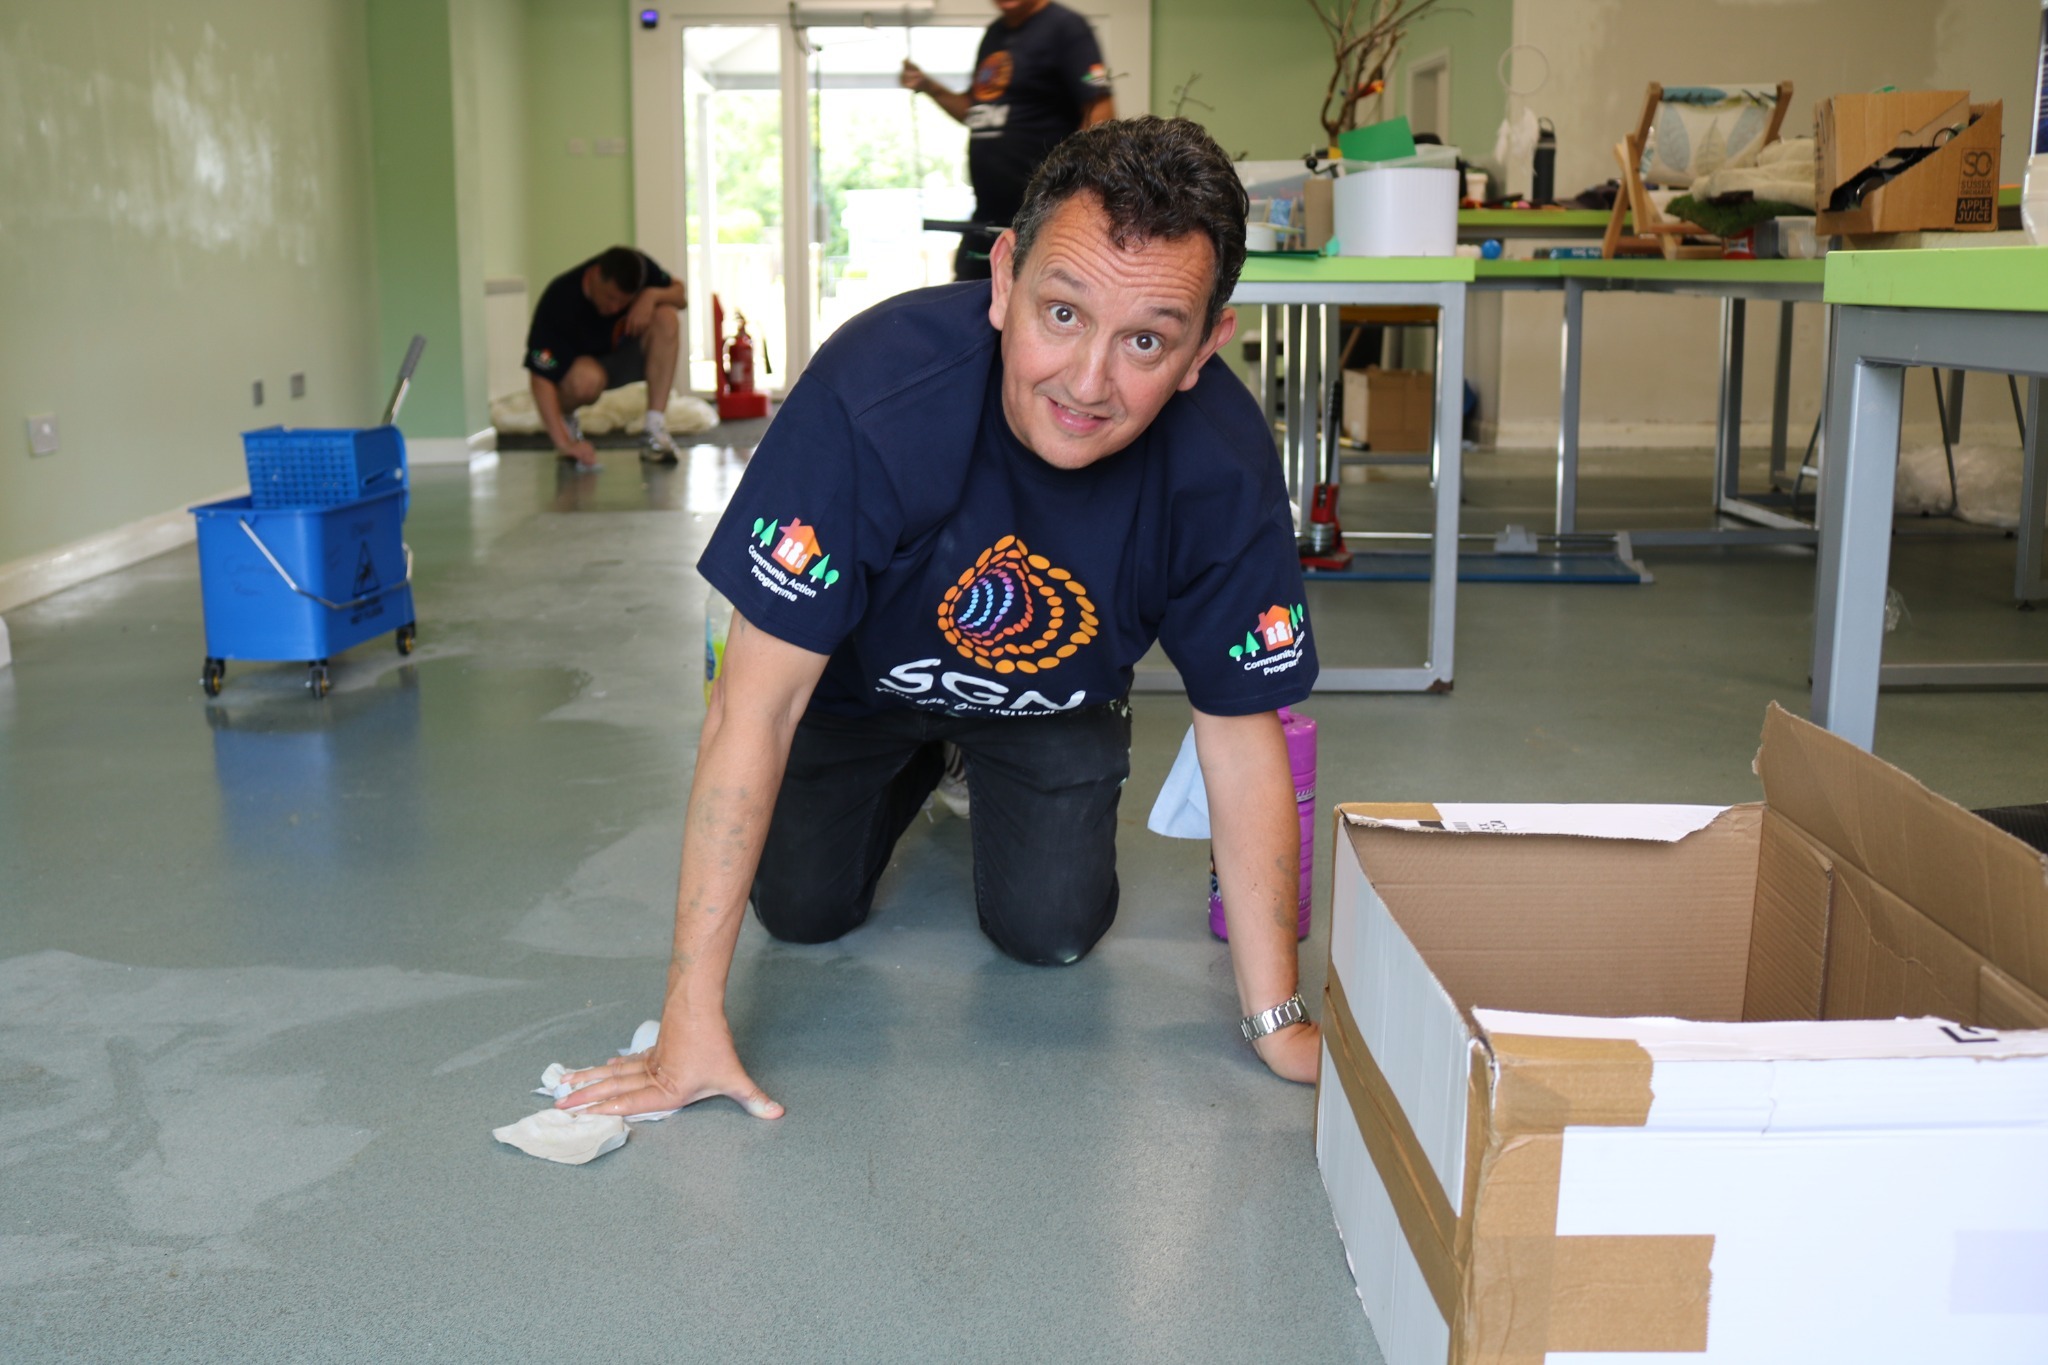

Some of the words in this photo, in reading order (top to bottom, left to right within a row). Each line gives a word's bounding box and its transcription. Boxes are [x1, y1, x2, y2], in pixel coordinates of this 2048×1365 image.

[1963, 152, 1992, 176] SO
[1961, 180, 1991, 189] SUSSEX
[1958, 211, 1990, 221] JUICE
[1959, 200, 1990, 210] APPLE
[748, 544, 789, 586] Community
[787, 578, 817, 598] Action
[751, 564, 798, 602] Programme
[1244, 649, 1297, 671] Community
[878, 658, 1086, 711] SGN
